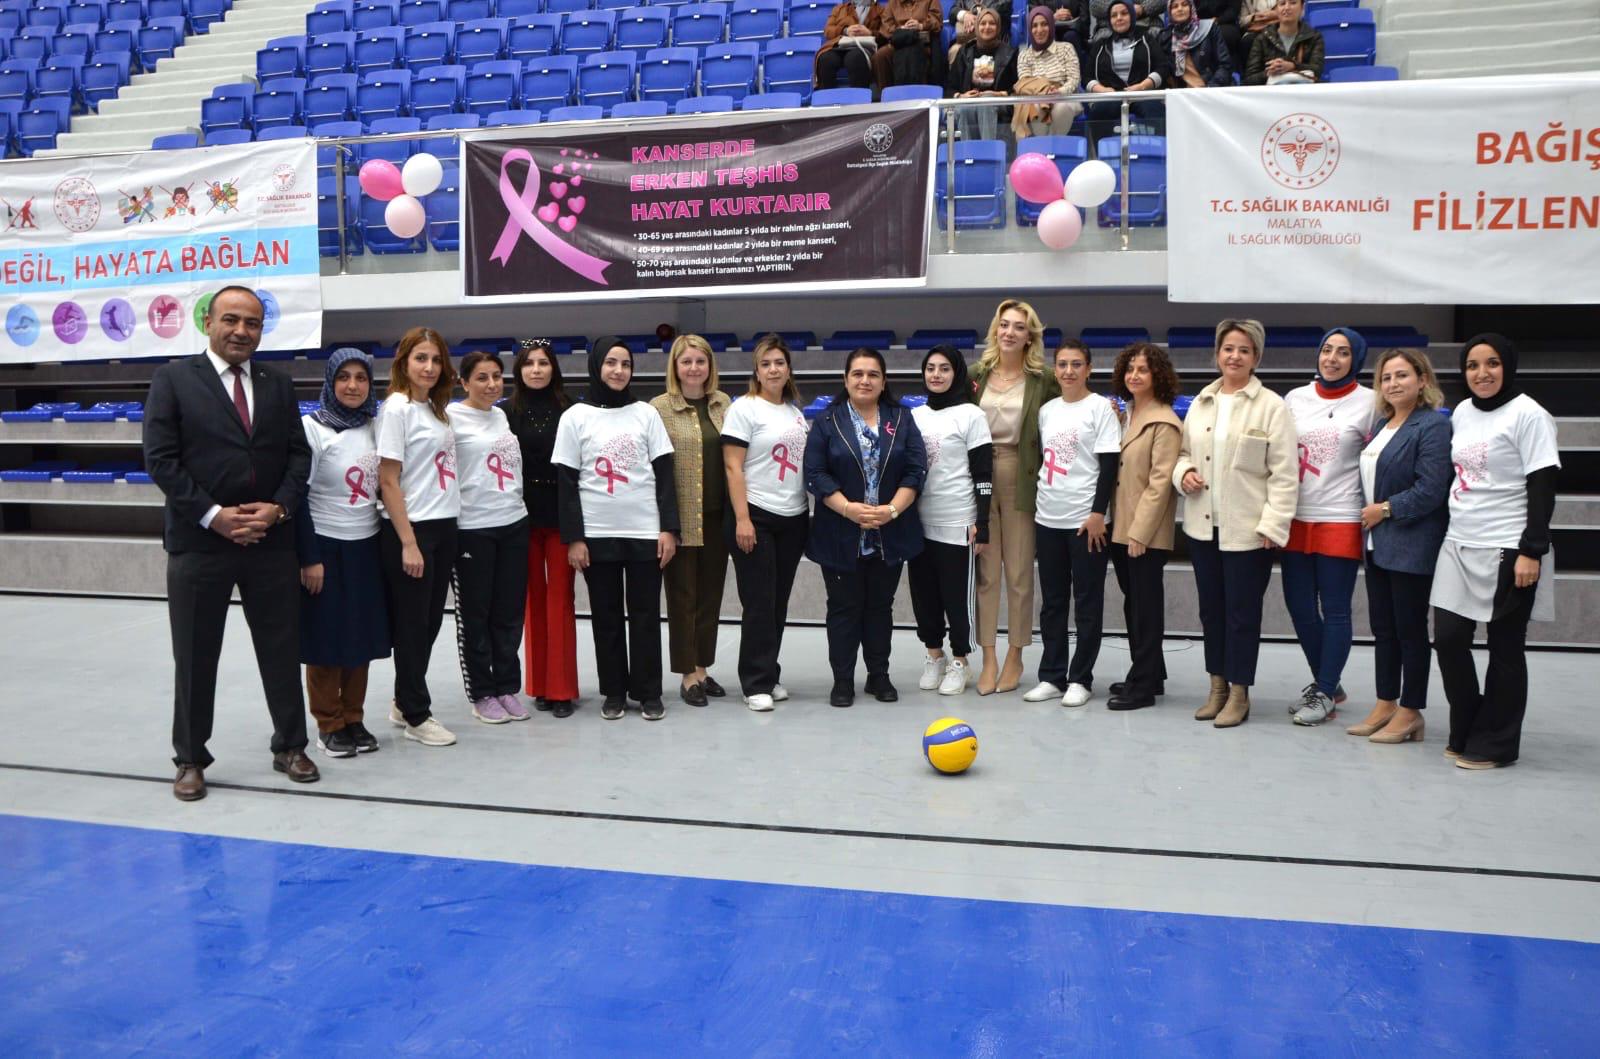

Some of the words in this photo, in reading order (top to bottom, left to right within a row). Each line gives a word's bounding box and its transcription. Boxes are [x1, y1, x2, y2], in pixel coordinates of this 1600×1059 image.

[631, 139, 755, 164] KANSERDE
[1476, 121, 1600, 170] BAĞIŞ
[630, 169, 707, 192] ERKEN
[714, 161, 799, 188] TEŞHİS
[631, 200, 703, 222] HAYAT
[710, 192, 831, 217] KURTARIR
[1210, 199, 1238, 213] T.C.
[1241, 196, 1299, 213] SAĞLIK
[1302, 196, 1390, 213] BAKANLIĞI
[1412, 190, 1600, 231] FİLİZLEN
[638, 232, 660, 240] 30-65
[674, 229, 712, 239] arasındaki
[713, 227, 743, 236] kadınlar
[750, 226, 769, 235] yılda
[770, 225, 781, 233] bir
[782, 224, 804, 232] rahim
[804, 222, 821, 232] ağzı
[822, 221, 852, 230] kanseri,
[1267, 218, 1322, 229] MALATYA
[675, 243, 713, 252] arasındaki
[713, 241, 744, 250] kadınlar
[744, 241, 750, 249] 2
[751, 240, 770, 249] yılda
[770, 239, 781, 247] bir
[782, 239, 806, 247] meme
[807, 236, 837, 245] kanseri,
[1228, 233, 1239, 246] İL
[1241, 232, 1281, 245] SAĞLIK
[1284, 232, 1361, 245] MÜDÜRLÜĞÜ
[0, 252, 65, 285] EĞİL,
[75, 249, 173, 281] HAYATA
[182, 237, 289, 272] BAĞLAN
[636, 259, 659, 267] 50-70
[673, 257, 711, 266] arasındaki
[712, 255, 742, 264] kadınlar
[754, 254, 785, 262] erkekler
[792, 252, 811, 262] yılda
[812, 251, 824, 260] bir
[636, 269, 654, 278] kalın
[655, 268, 687, 278] bağırsak
[687, 266, 714, 275] kanseri
[715, 265, 755, 275] taramanızı
[756, 263, 794, 273] YAPTIRIN.
